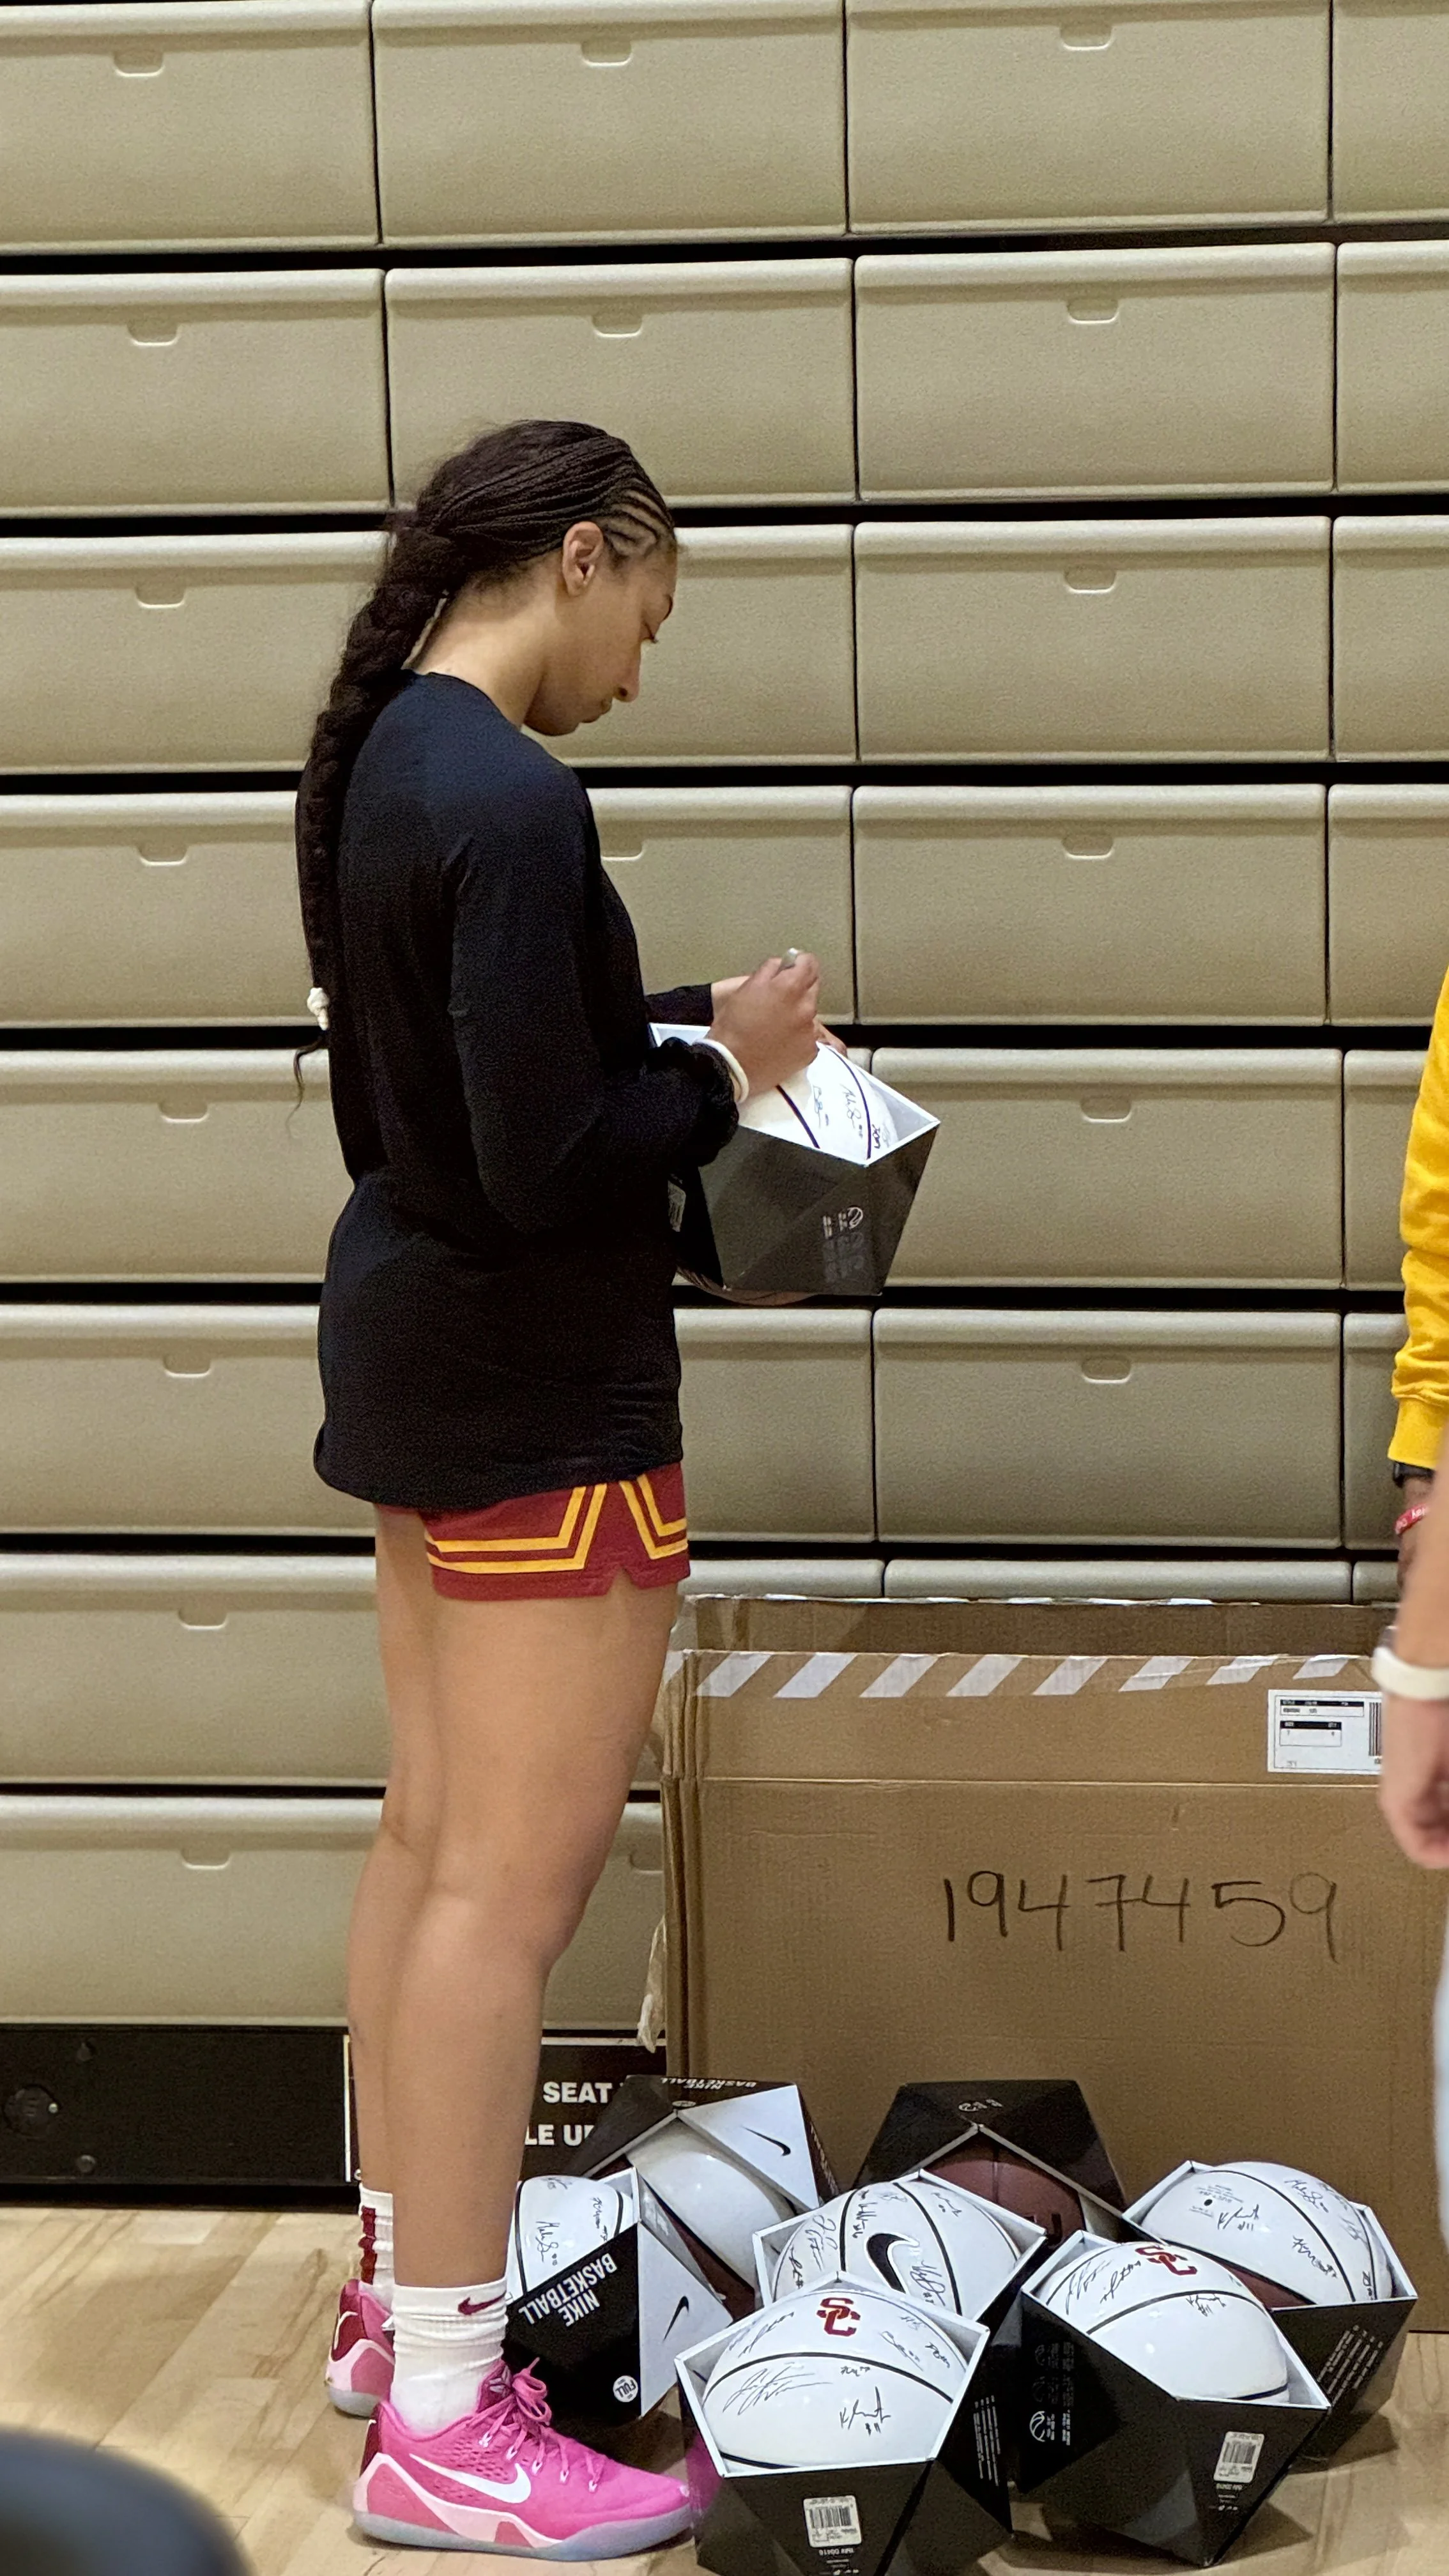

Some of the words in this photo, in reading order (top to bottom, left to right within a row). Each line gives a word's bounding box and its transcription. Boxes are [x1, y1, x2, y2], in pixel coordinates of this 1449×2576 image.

[944, 1870, 1338, 1963] 1947459
[542, 2081, 612, 2103] SEAT
[661, 2077, 758, 2089] BASKETBALL
[1135, 2245, 1198, 2276] SC
[518, 2253, 618, 2325] BASKETBALL
[558, 2289, 600, 2327] NIKE
[816, 2297, 861, 2336] SC
[615, 2379, 637, 2398] FULL
